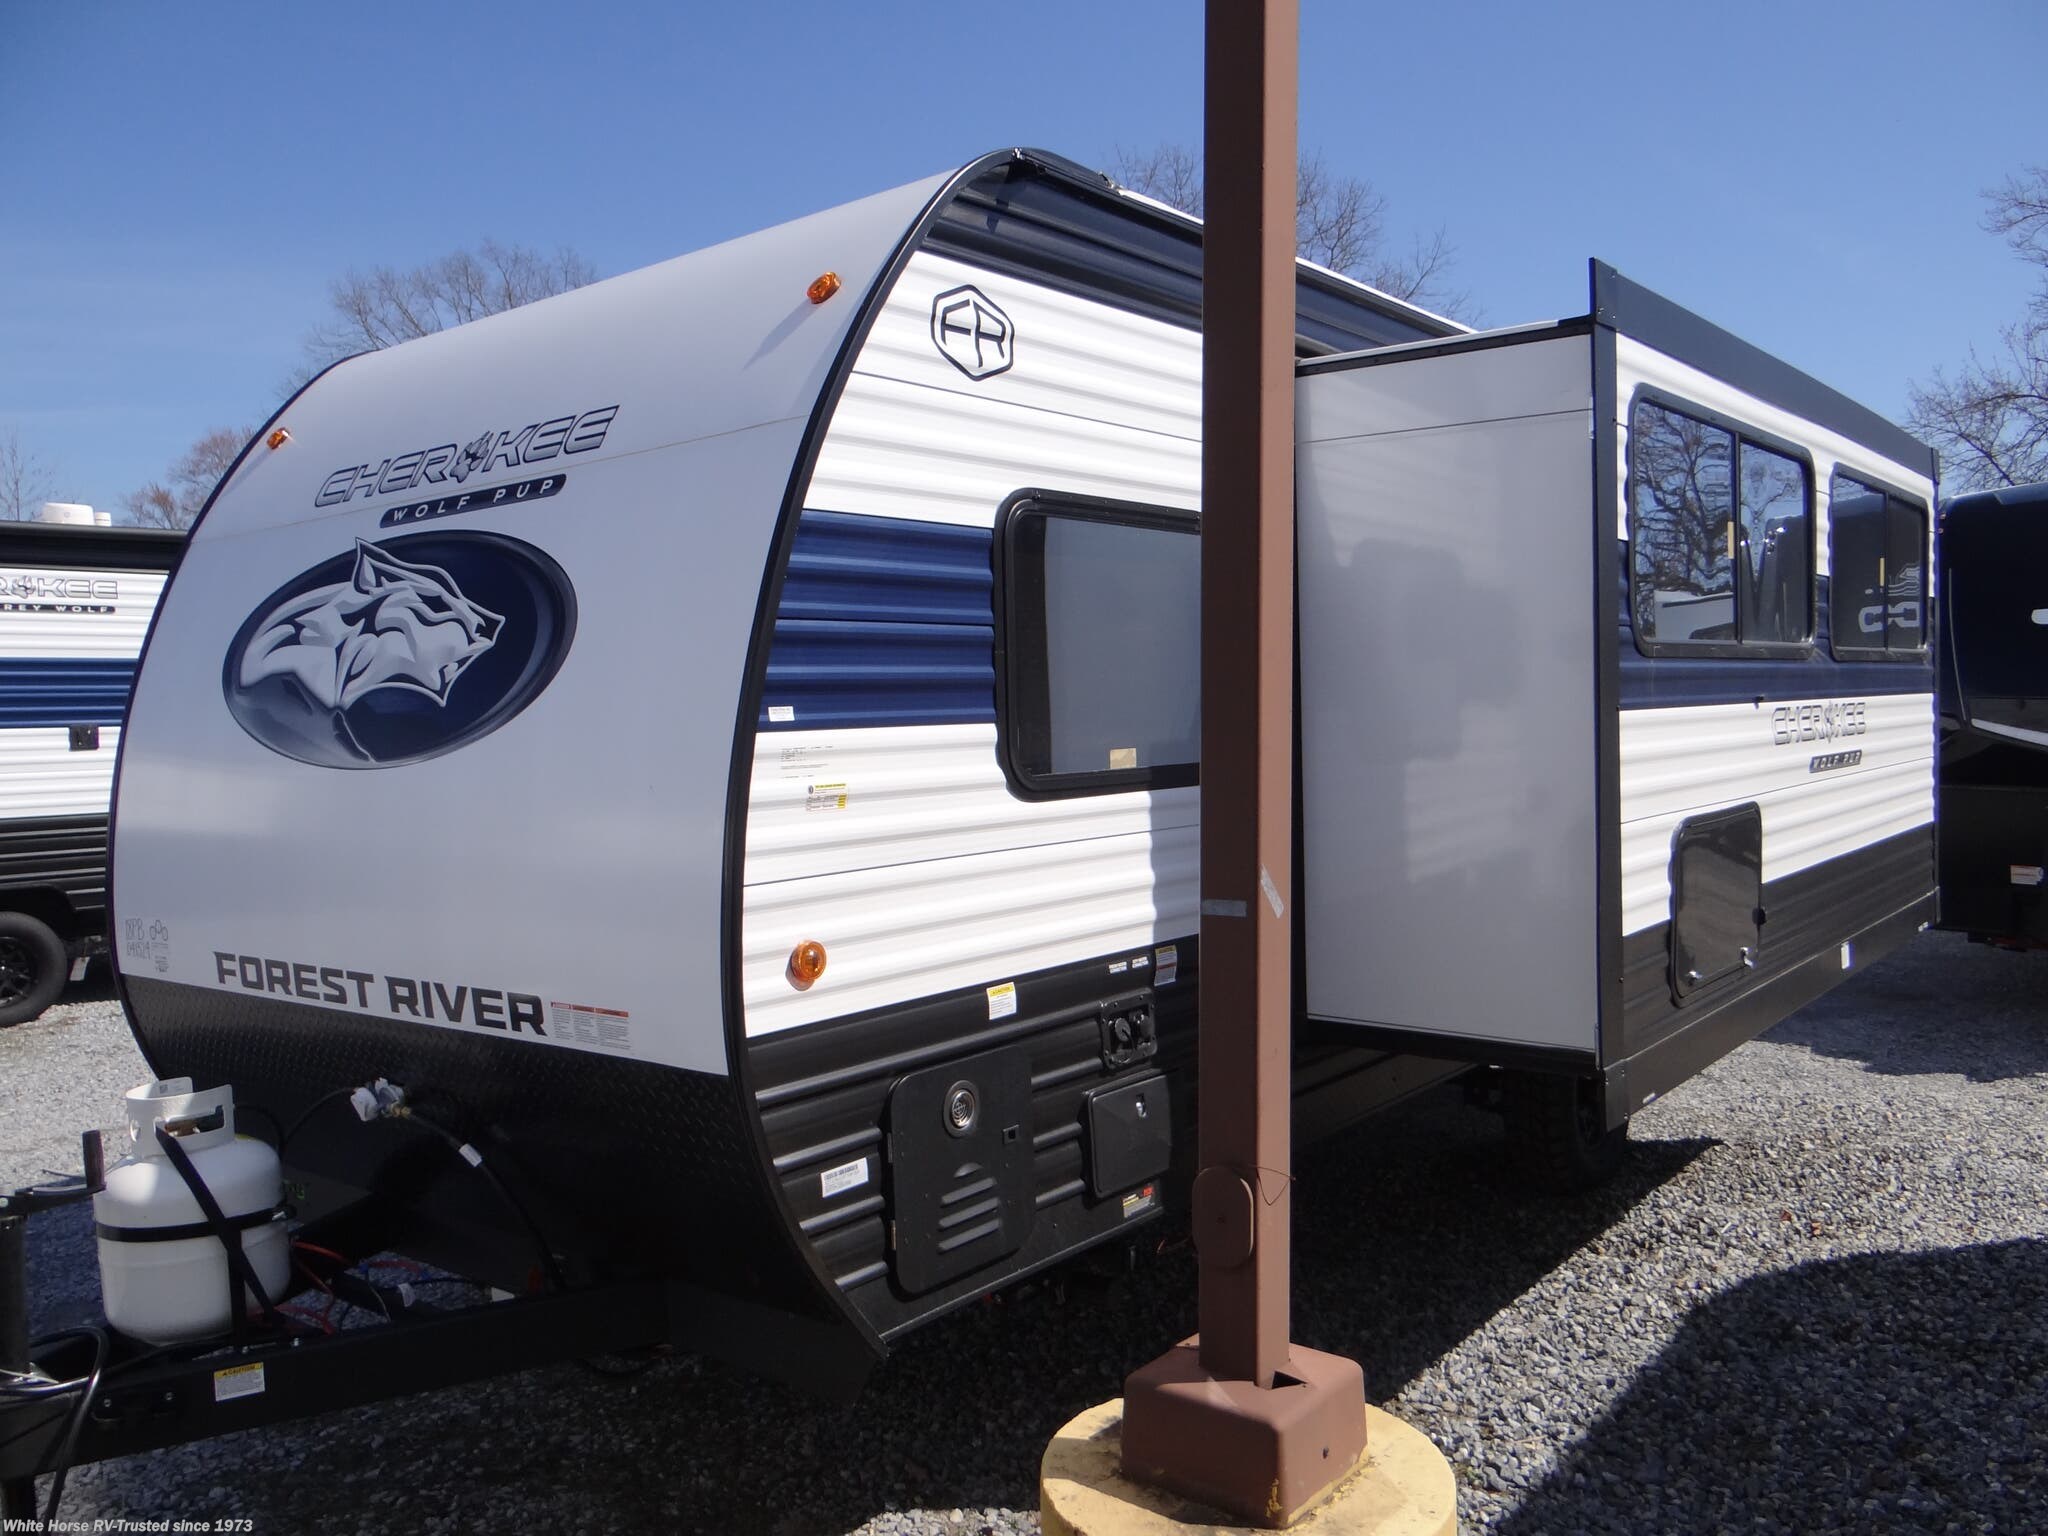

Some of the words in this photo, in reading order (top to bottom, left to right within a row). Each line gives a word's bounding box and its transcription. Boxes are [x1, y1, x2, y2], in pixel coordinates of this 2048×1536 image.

[314, 404, 620, 508] CHEROKEE
[393, 495, 470, 522] WOLF
[492, 478, 555, 504] PUP
[55, 604, 108, 614] WOLF
[1772, 702, 1866, 745] CHEROKEE
[213, 951, 375, 1008] FOREST
[384, 975, 547, 1036] RIVER
